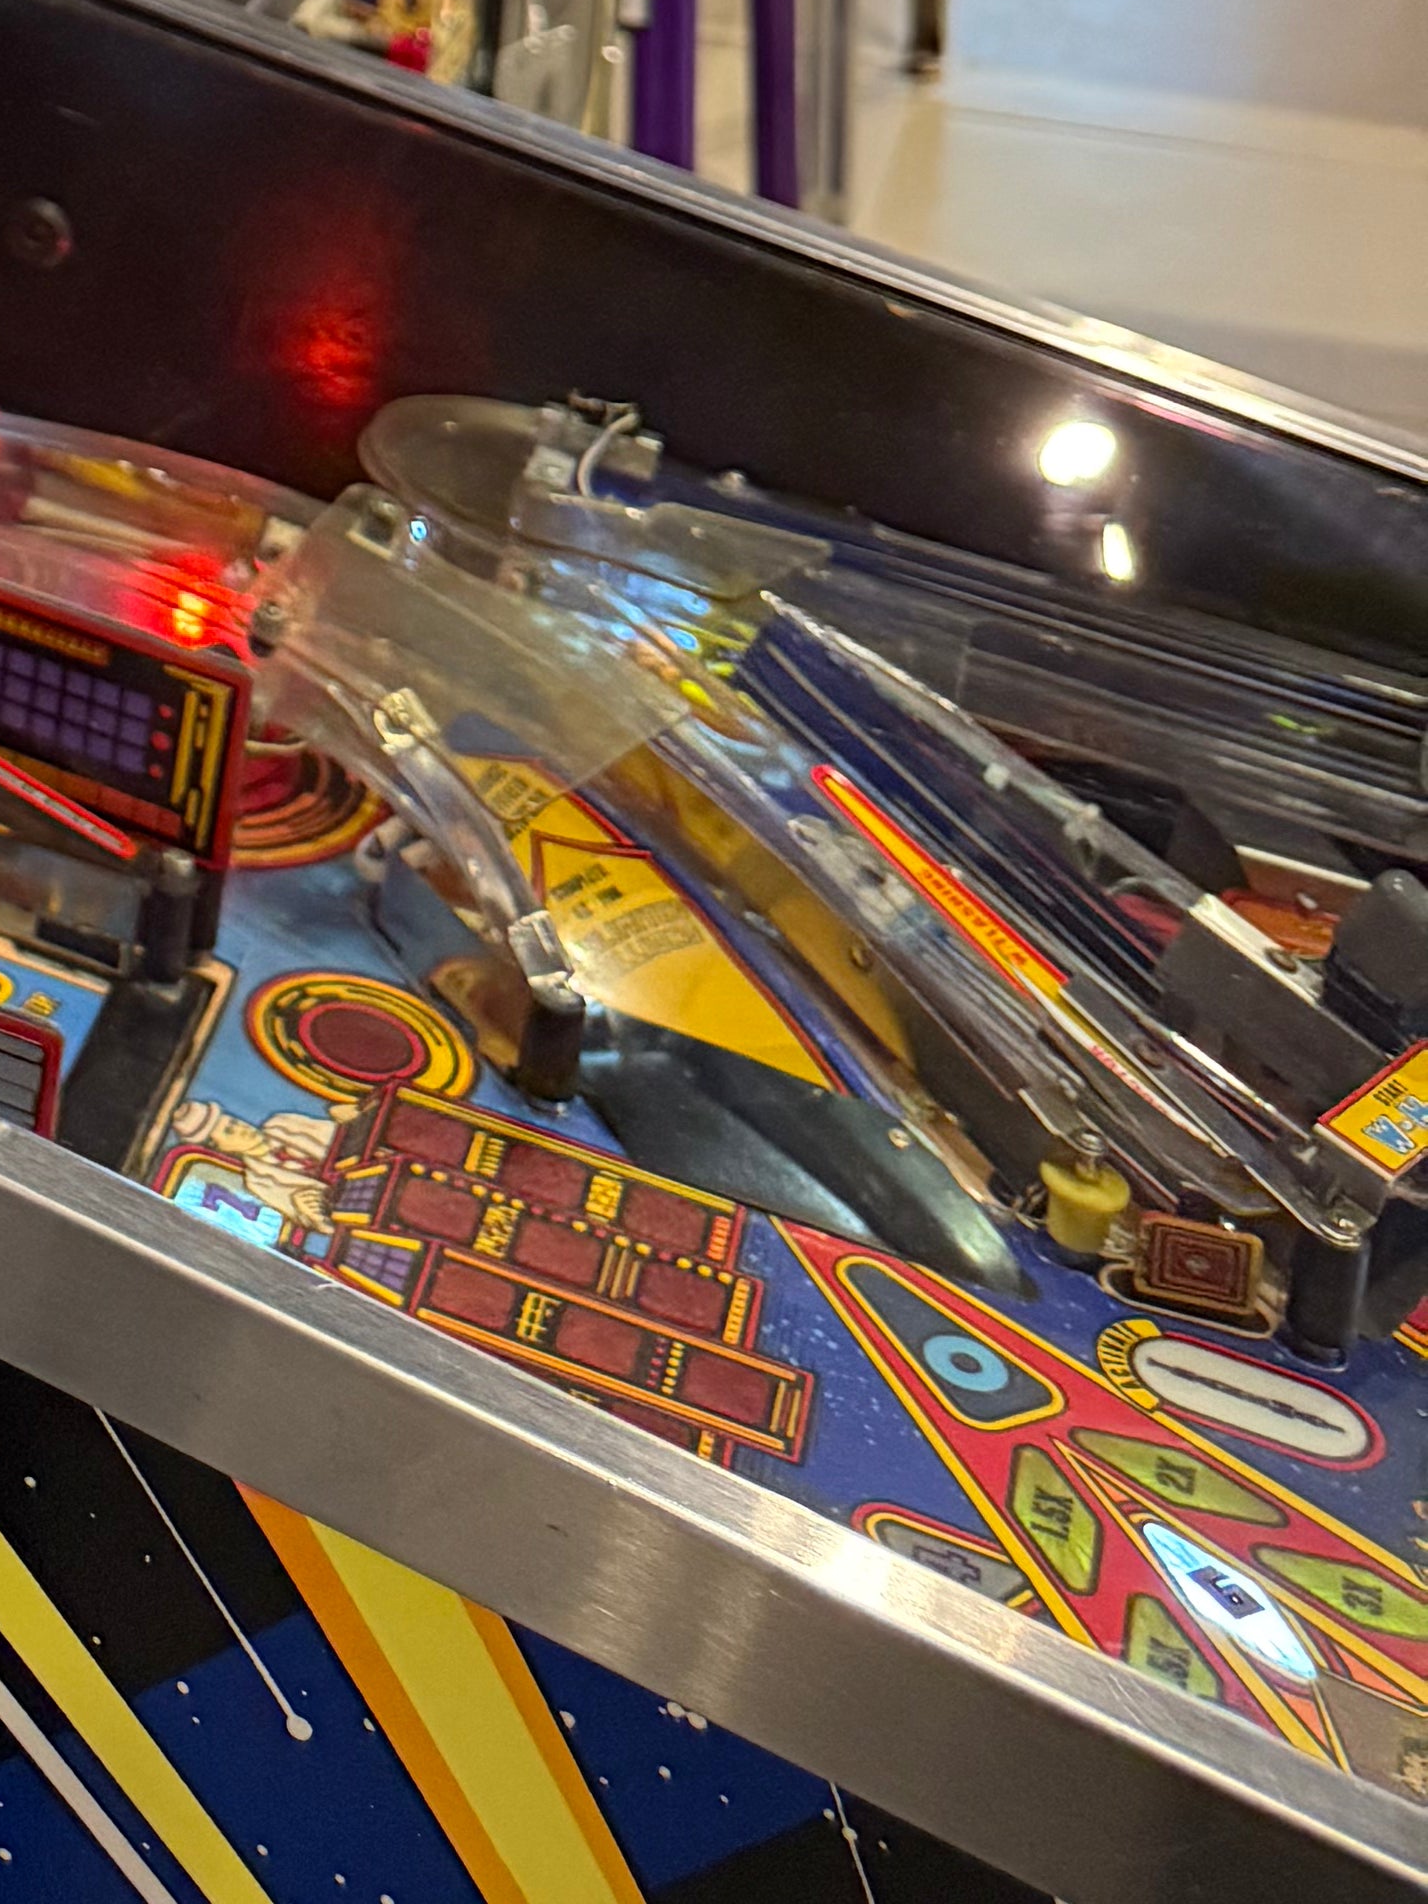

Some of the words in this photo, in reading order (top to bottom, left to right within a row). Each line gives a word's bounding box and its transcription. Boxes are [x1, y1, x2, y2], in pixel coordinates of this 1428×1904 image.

[1155, 1455, 1199, 1495] 2X
[1341, 1575, 1385, 1617] 3X
[1145, 1638, 1193, 1693] .5X
